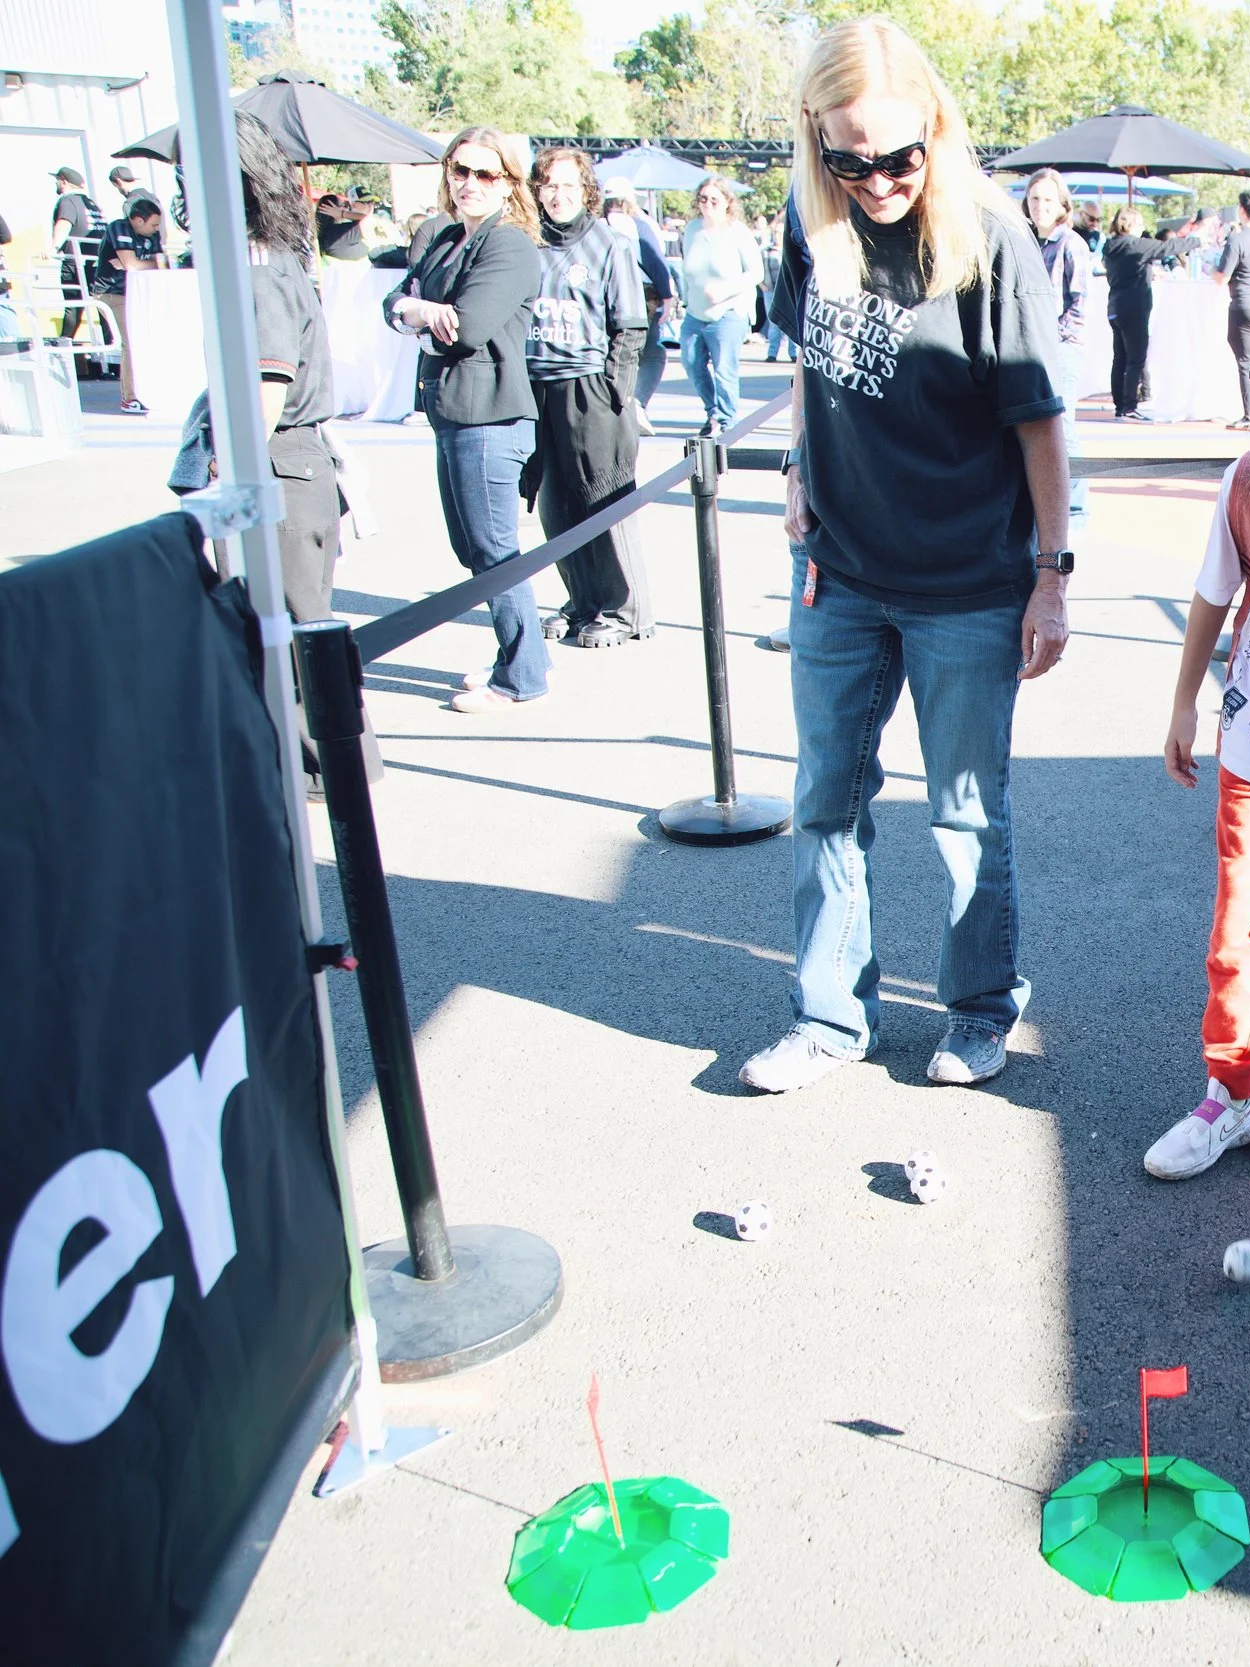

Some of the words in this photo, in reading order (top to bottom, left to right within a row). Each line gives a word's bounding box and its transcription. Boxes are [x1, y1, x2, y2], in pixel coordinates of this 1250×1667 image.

[802, 318, 898, 379] WOMEN'S
[805, 292, 904, 356] WATCHES
[803, 346, 884, 399] SPORTS.
[0, 1004, 249, 1560] er
